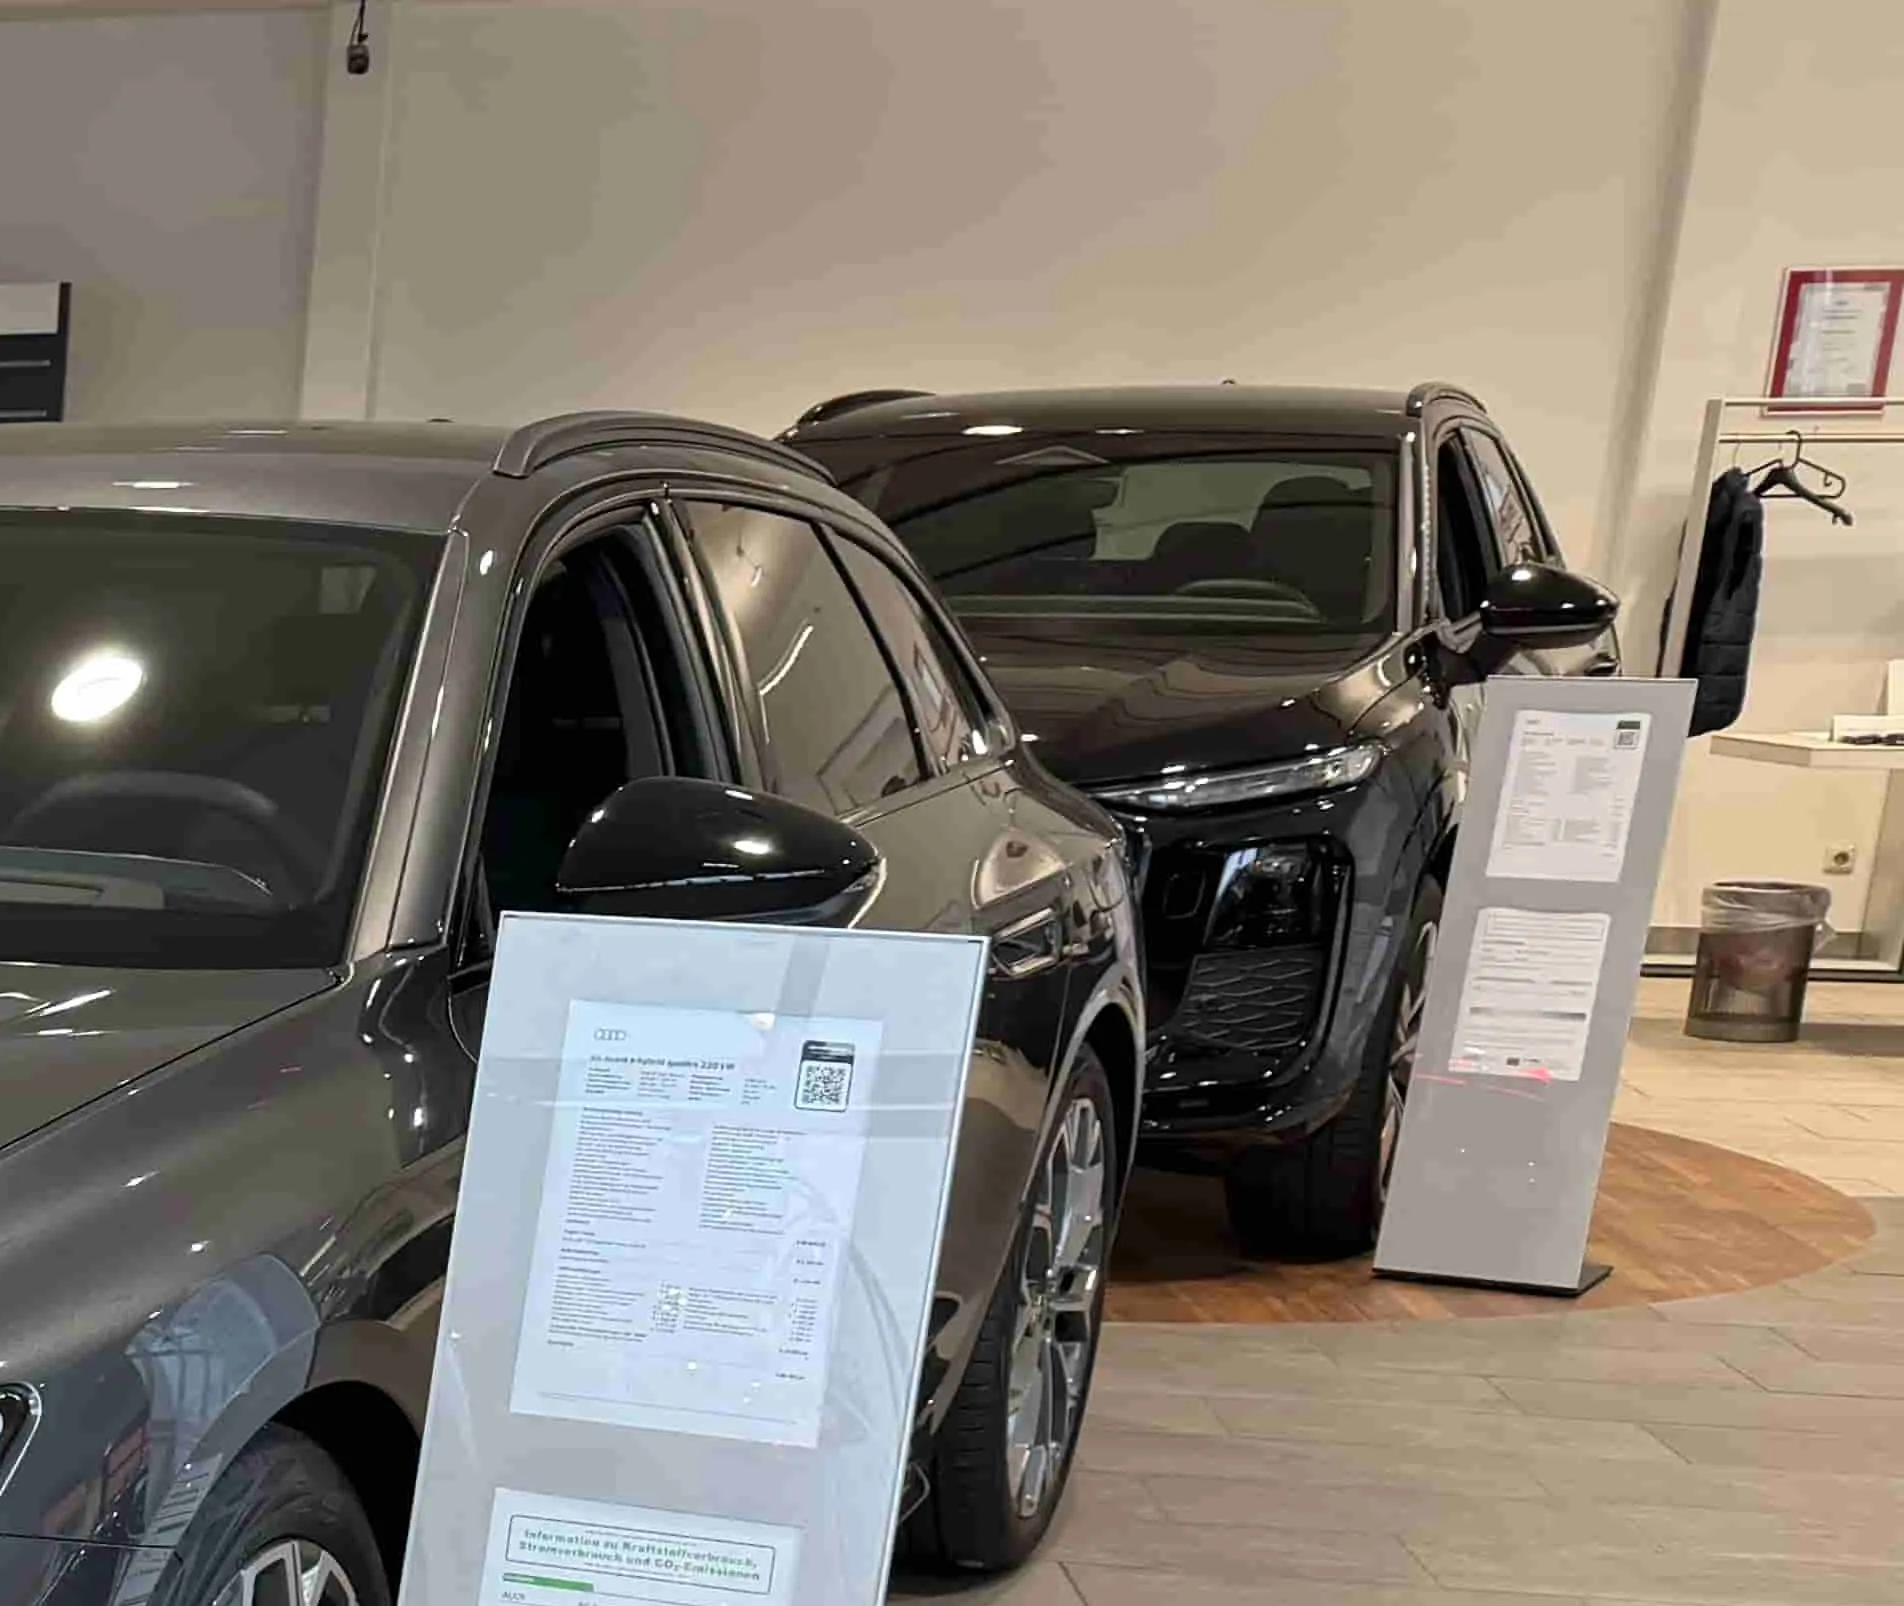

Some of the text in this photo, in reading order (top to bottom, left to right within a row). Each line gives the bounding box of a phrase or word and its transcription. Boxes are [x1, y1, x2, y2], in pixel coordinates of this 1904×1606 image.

[519, 1540, 622, 1563] Stromverbrauch
[625, 1553, 650, 1567] und
[524, 1528, 600, 1548] Information
[603, 1539, 619, 1550] zu
[622, 1540, 758, 1569] Kraftstoffverbrauch,
